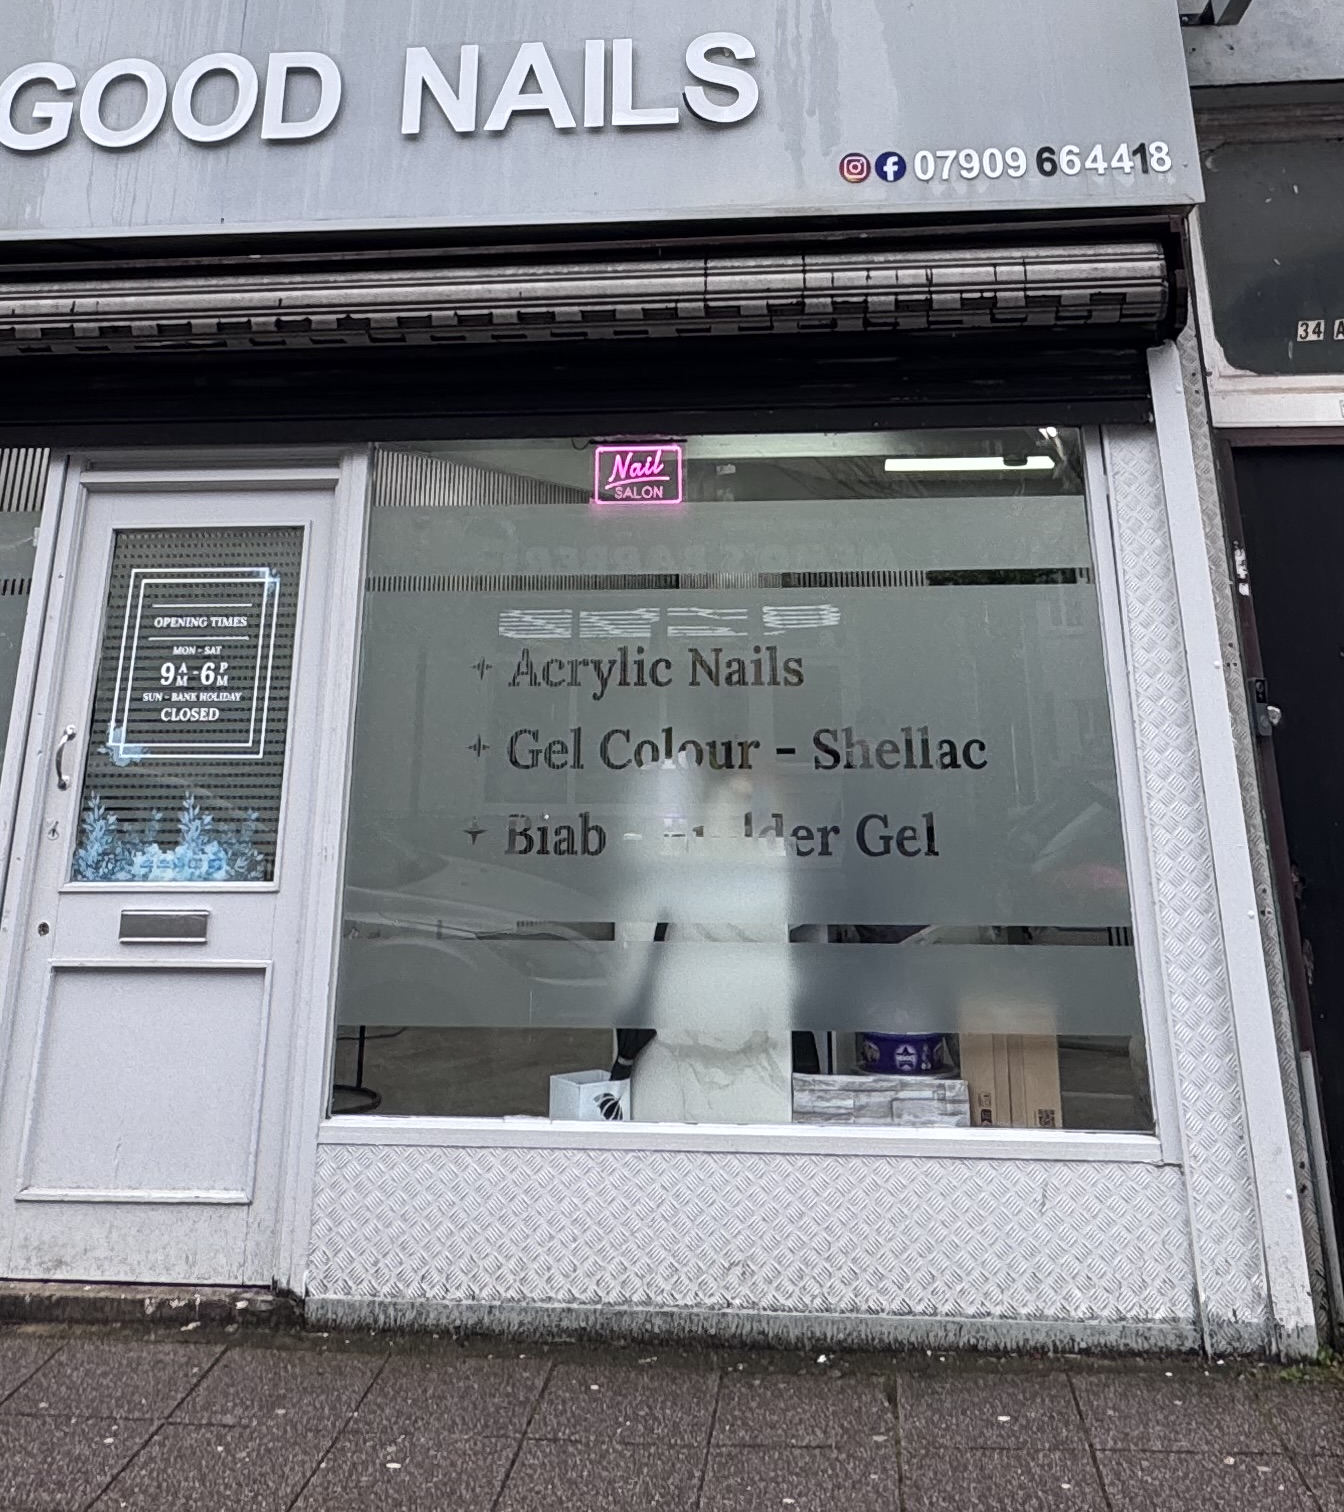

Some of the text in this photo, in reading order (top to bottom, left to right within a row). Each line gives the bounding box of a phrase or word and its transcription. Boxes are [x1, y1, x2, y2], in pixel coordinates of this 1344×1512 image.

[401, 30, 761, 136] NAILS
[913, 141, 1173, 182] 07909 664418
[1299, 321, 1323, 340] 34
[607, 448, 665, 483] Nail
[614, 485, 664, 500] SALON
[153, 616, 248, 628] OPENING TIMES
[172, 645, 196, 656] MON
[204, 645, 223, 656] SAT
[507, 645, 805, 701] Acrylic Nails
[142, 691, 163, 702] SUN
[171, 691, 198, 702] BANK
[199, 691, 243, 702] HOLIDAY
[160, 707, 220, 722] CLOSED
[506, 725, 988, 770] Gel Colour - Shellac
[505, 811, 607, 857] Biab
[659, 811, 841, 858] lder
[855, 811, 940, 858] Gel
